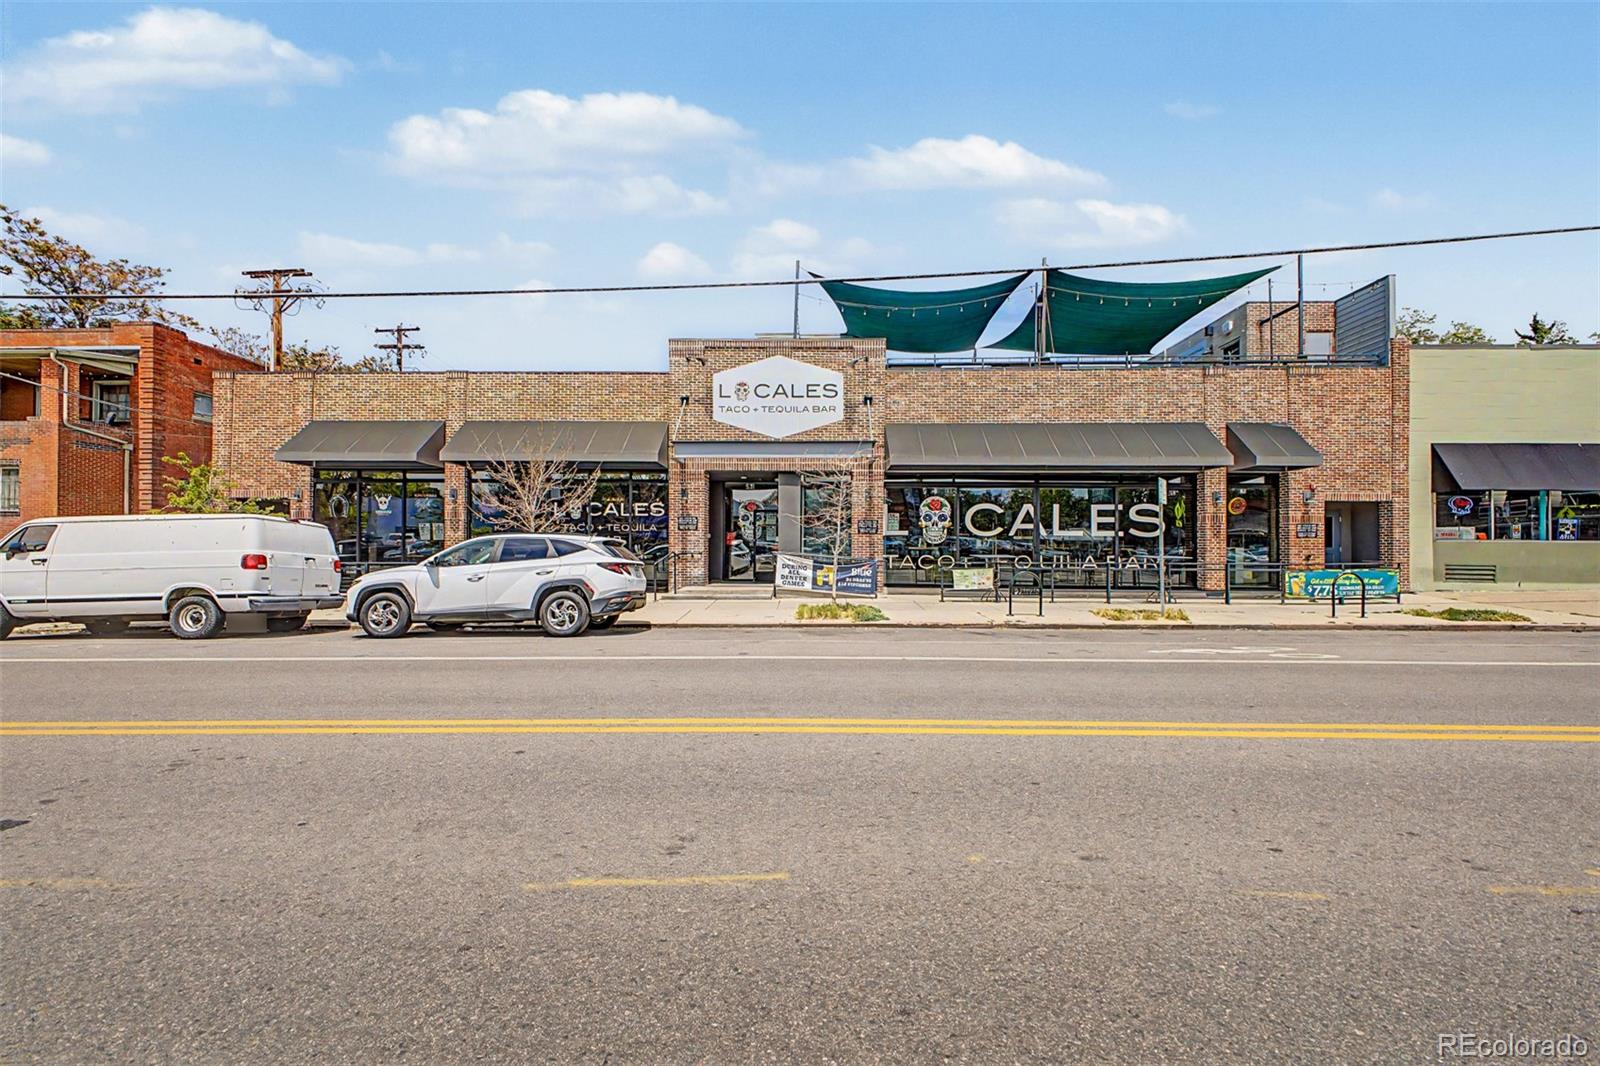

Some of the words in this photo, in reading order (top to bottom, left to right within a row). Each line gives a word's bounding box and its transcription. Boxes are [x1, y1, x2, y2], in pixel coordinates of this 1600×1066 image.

[719, 405, 750, 413] TACO
[762, 405, 810, 413] TEQUILA
[812, 405, 837, 413] BAR
